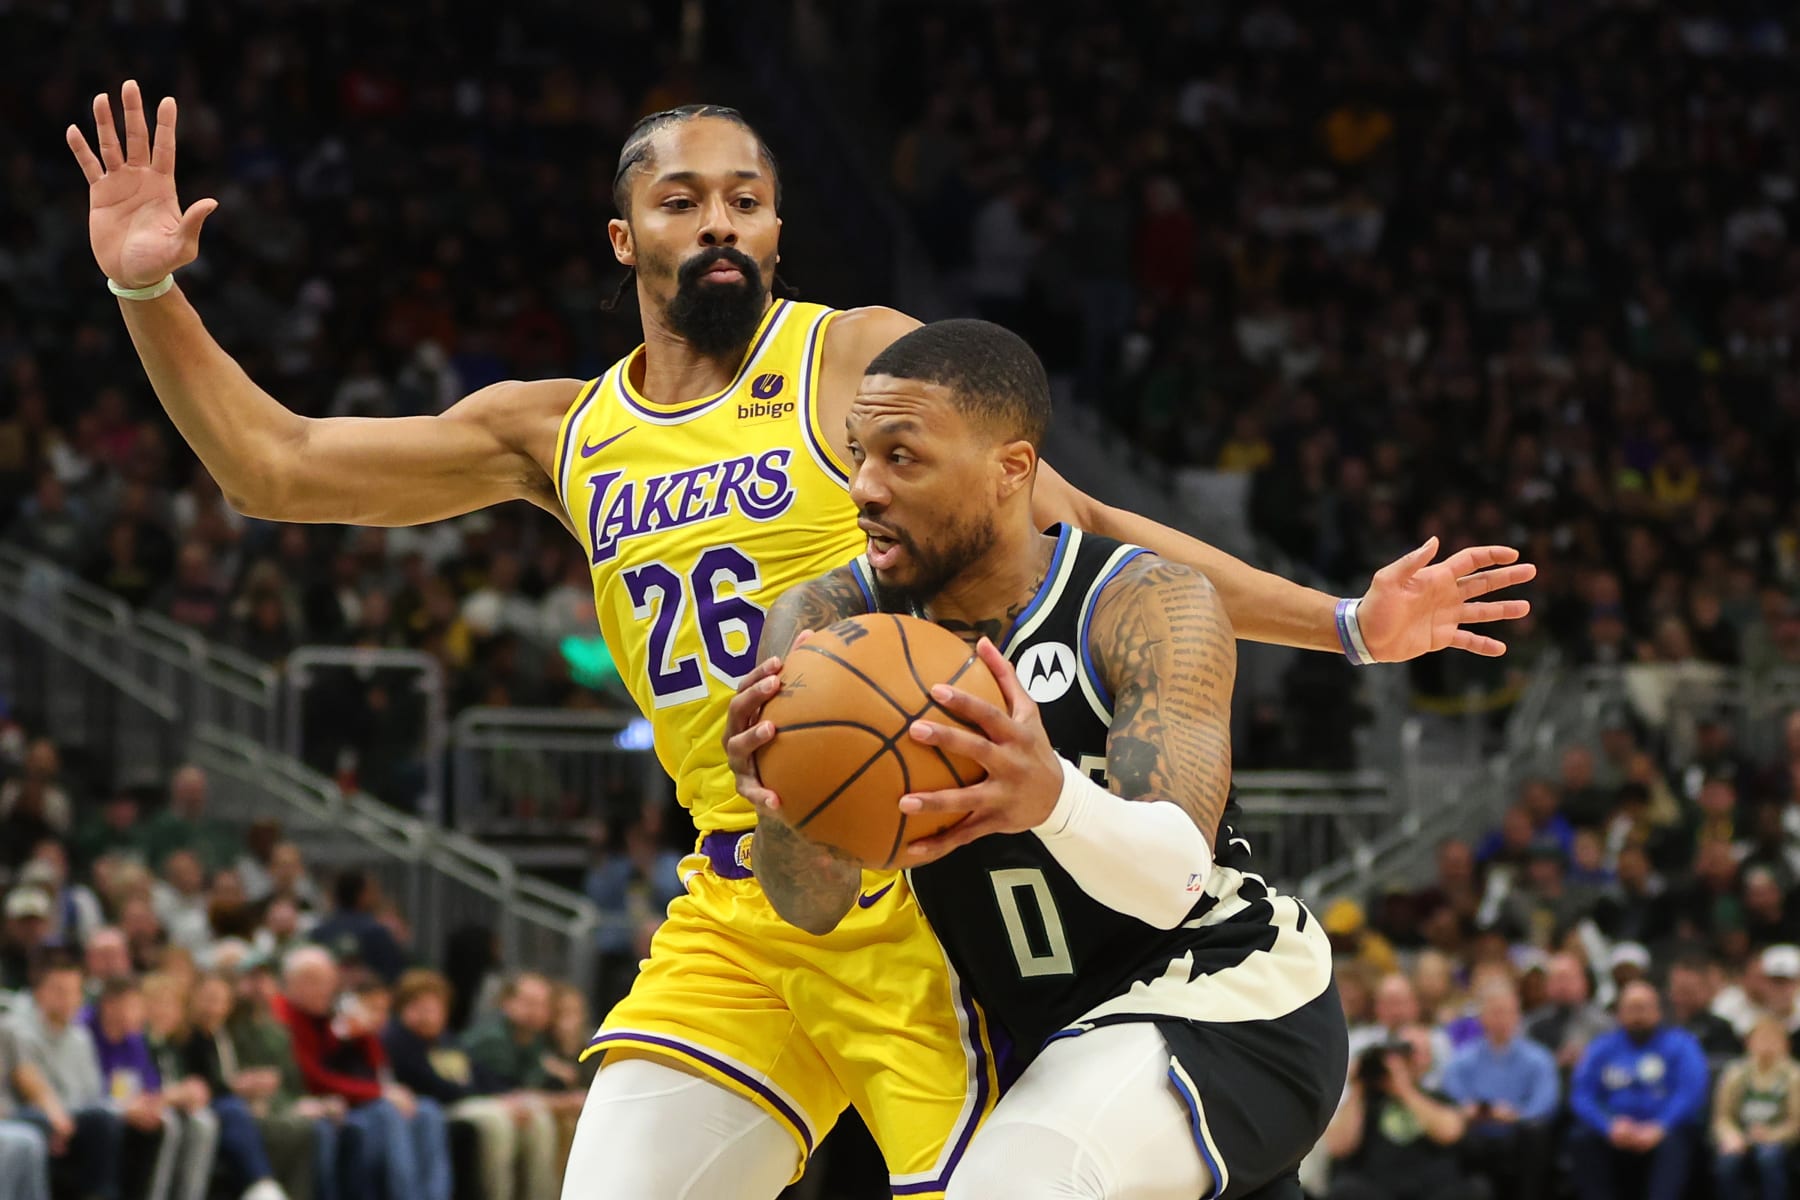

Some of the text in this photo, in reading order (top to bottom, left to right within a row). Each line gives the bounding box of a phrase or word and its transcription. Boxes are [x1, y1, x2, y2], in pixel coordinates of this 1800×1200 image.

[737, 401, 795, 419] bibigo
[586, 447, 796, 569] LAKERS
[619, 543, 768, 710] 26
[988, 868, 1075, 978] 0
